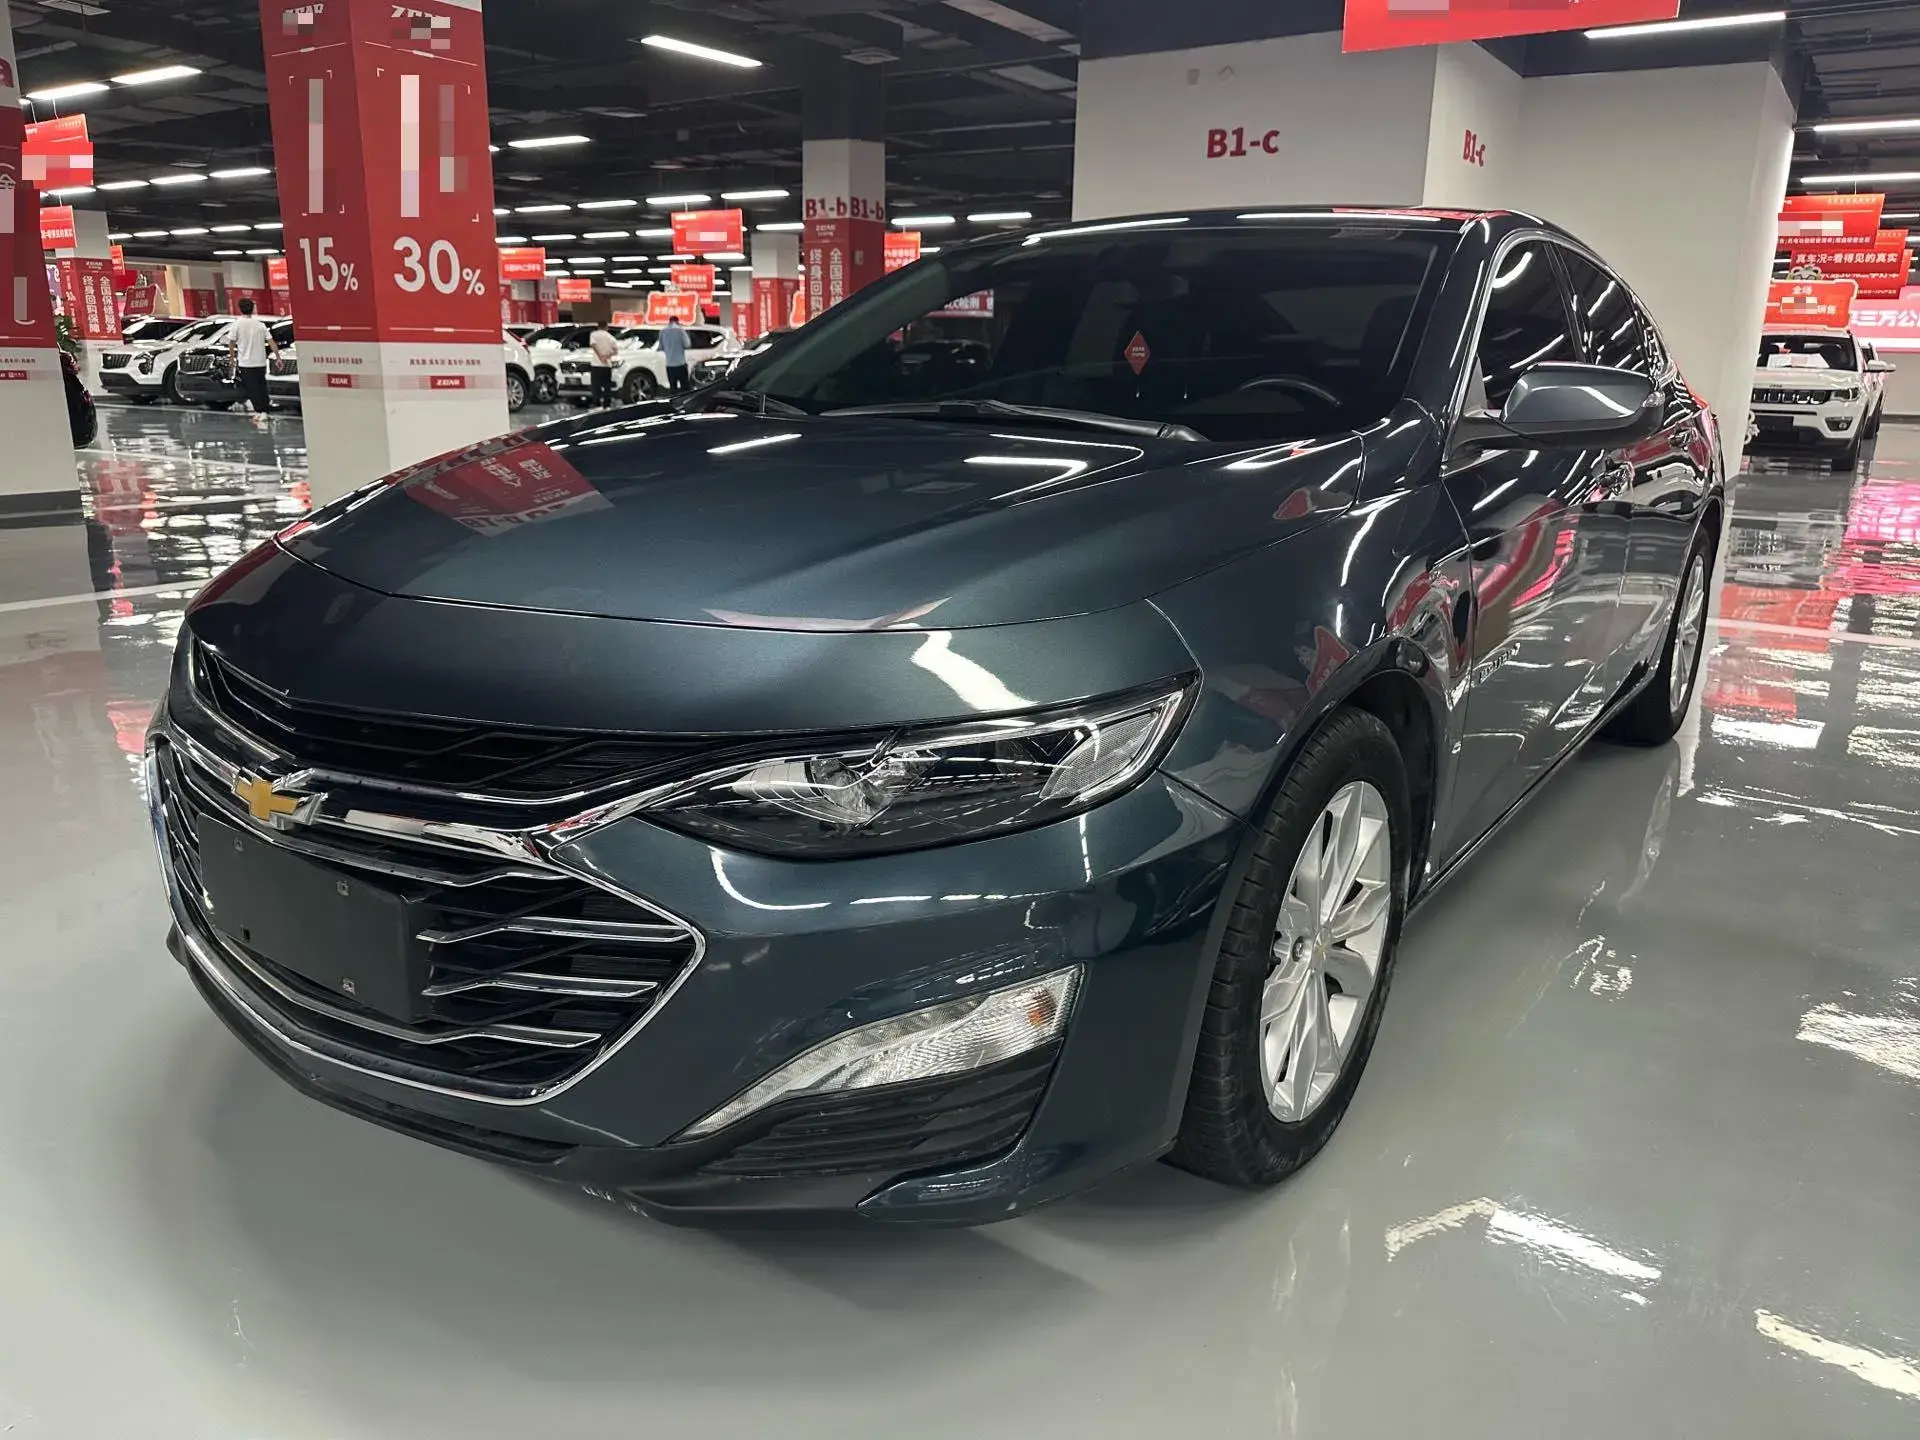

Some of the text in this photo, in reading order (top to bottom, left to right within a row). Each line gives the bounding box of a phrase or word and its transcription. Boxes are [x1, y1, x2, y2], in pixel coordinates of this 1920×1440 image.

[1207, 127, 1280, 158] B1-c
[1463, 129, 1486, 167] B1-c
[806, 197, 847, 218] B1-b
[851, 197, 884, 220] B1-b
[300, 237, 358, 291] 15%
[394, 236, 485, 296] 30%
[1796, 253, 1897, 264] 真车况=看得见的真实
